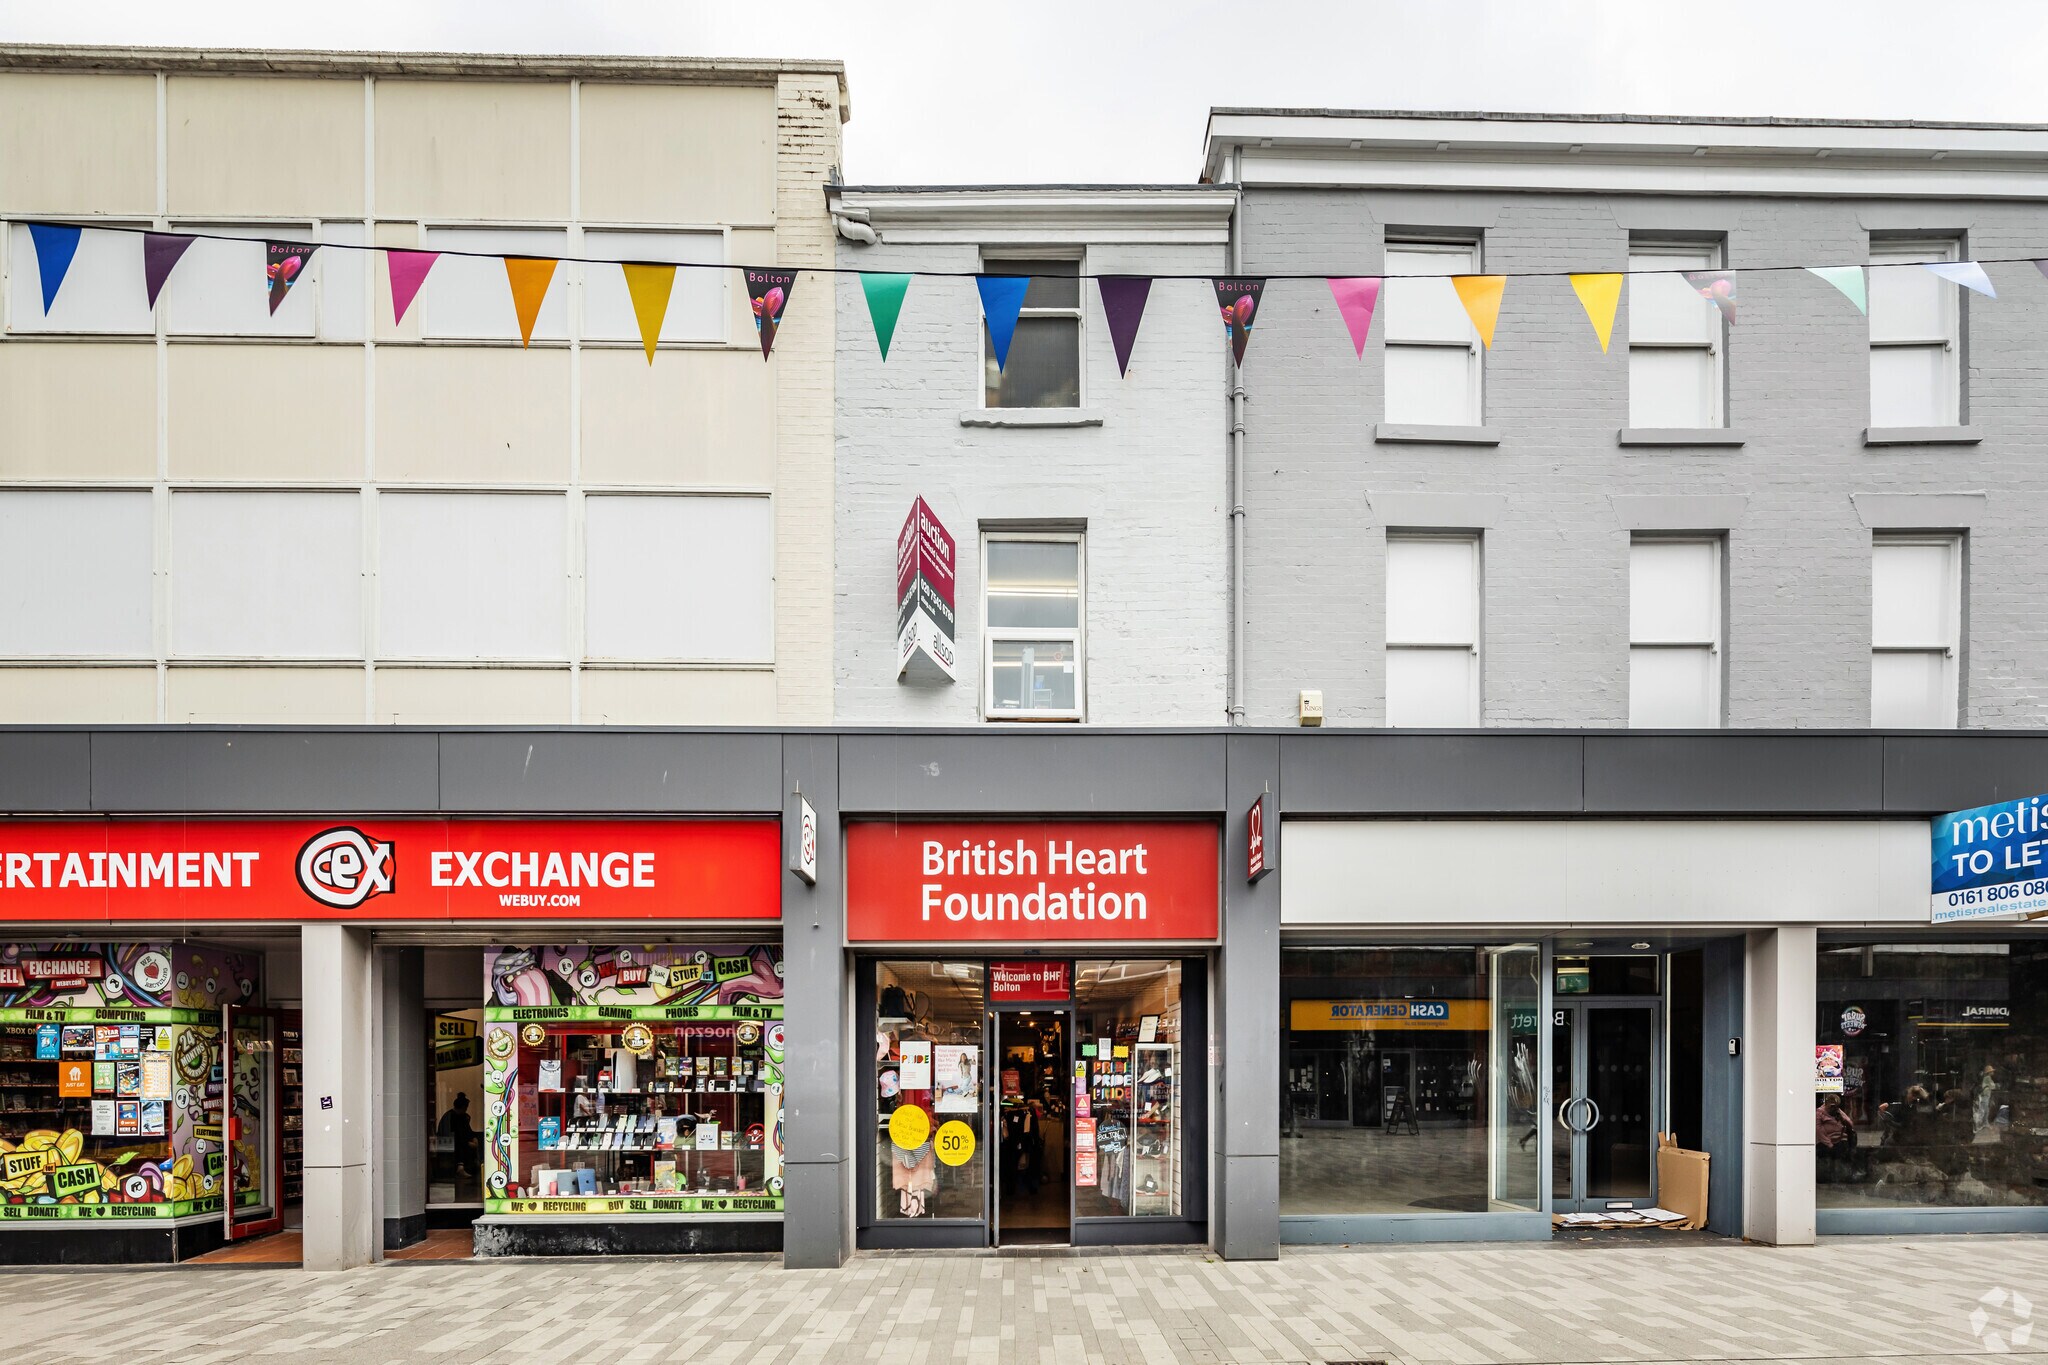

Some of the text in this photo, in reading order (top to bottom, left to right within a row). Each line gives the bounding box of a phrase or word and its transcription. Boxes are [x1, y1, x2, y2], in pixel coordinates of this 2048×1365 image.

[270, 245, 310, 254] Bolton
[749, 272, 790, 283] Bolton
[1219, 281, 1259, 291] Bolton
[920, 512, 950, 562] auction
[933, 632, 954, 668] allsop
[922, 839, 1147, 876] British Heart
[1952, 849, 1994, 877] TO
[0, 852, 260, 888] RTAINMENT
[430, 851, 655, 888] EXCHANGE
[1948, 880, 2048, 906] 0161 806 08
[499, 894, 581, 908] WEBUY.COM
[922, 882, 1147, 922] Foundation
[29, 960, 91, 976] EXCHANGE
[622, 969, 642, 982] BUY
[673, 967, 699, 983] STUFF
[717, 959, 749, 976] CASH
[993, 971, 1061, 982] Welcome to BHF
[993, 981, 1021, 992] Bolton
[25, 1009, 66, 1021] FILM & TV
[95, 1008, 146, 1021] COMPUTING
[513, 1007, 569, 1020] ELECTRONICS
[598, 1006, 632, 1019] GAMING
[665, 1006, 699, 1018] PHONES
[732, 1006, 773, 1019] FILM & TV
[6, 1027, 26, 1035] XBOX
[97, 1029, 105, 1040] 5
[440, 1022, 466, 1035] SELL
[180, 1029, 195, 1052] 24
[437, 1047, 472, 1064] HANGE
[902, 1054, 929, 1064] PRIDE
[1093, 1074, 1131, 1087] PRIDE
[196, 1129, 223, 1137] ELECTRONIC
[9, 1155, 42, 1173] STUFF
[57, 1168, 96, 1189] CASH
[78, 1205, 157, 1217] WE RECYCLING
[192, 1201, 204, 1212] WE
[511, 1200, 586, 1212] WE RECYCLING
[607, 1199, 683, 1211] BUY SELL DONATE
[701, 1198, 776, 1211] WE RECYCLING
[3, 1206, 59, 1218] SELL DONATE
